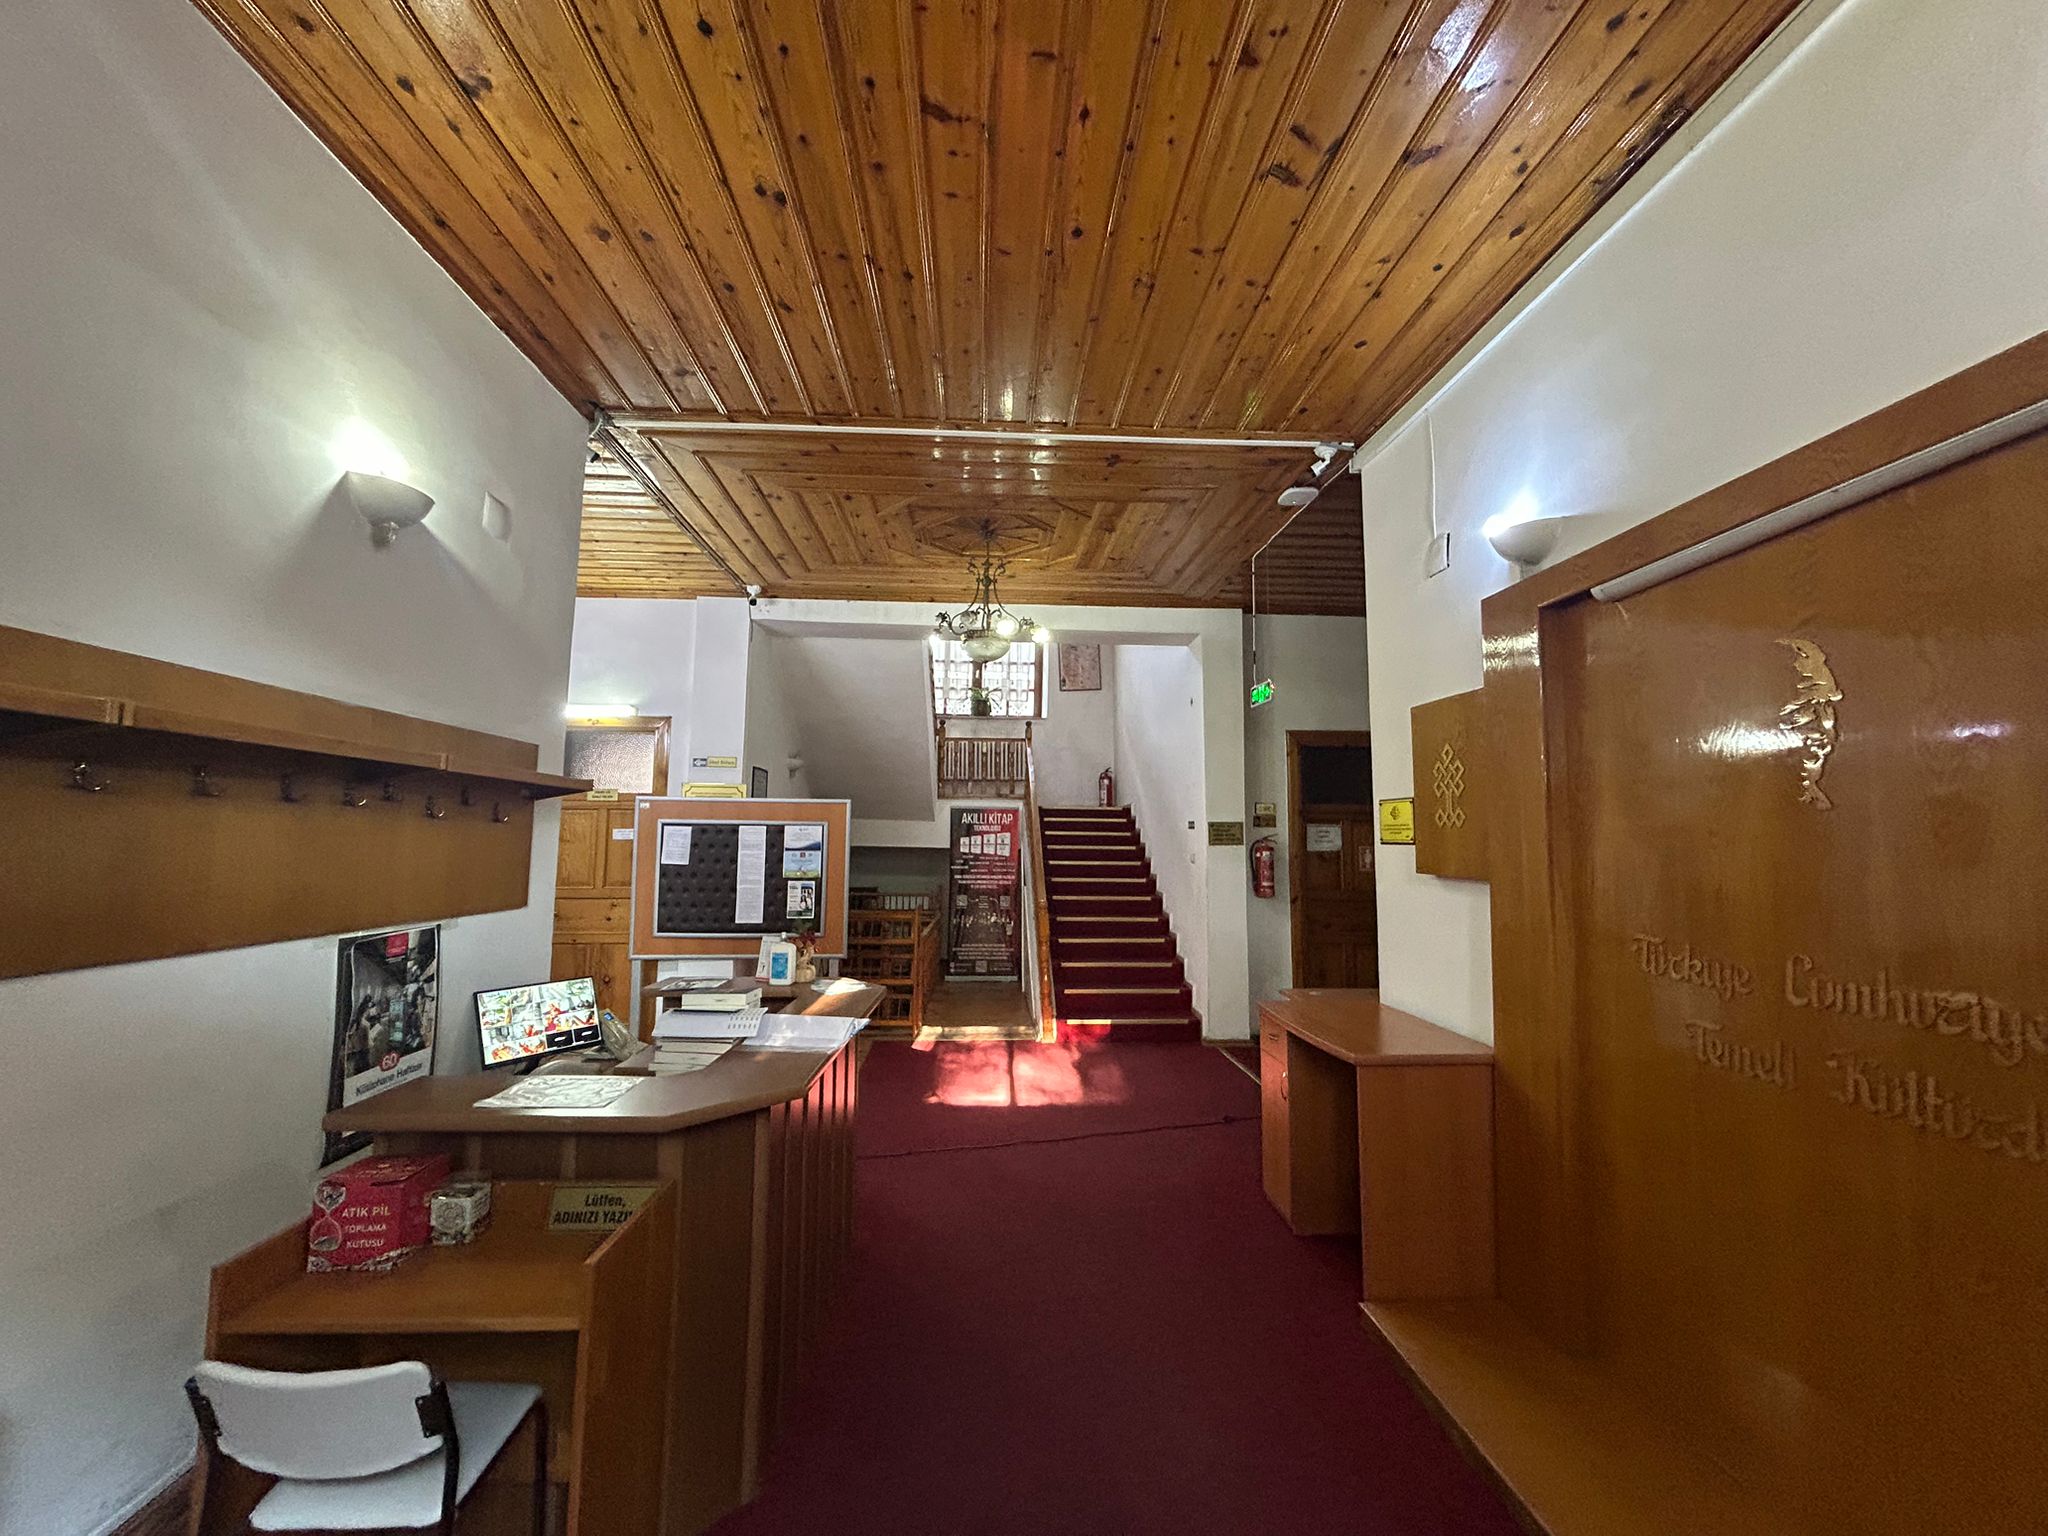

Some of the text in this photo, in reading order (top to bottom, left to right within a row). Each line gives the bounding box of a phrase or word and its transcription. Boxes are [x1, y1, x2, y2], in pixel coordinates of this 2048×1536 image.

[961, 811, 1013, 825] AKILLI KİTAP
[584, 1194, 626, 1208] Lütfen,
[342, 1203, 391, 1218] ATIK PİL
[553, 1210, 599, 1224] ADINIZI
[344, 1224, 387, 1234] TOPLAMA
[346, 1239, 385, 1249] KUTUSU
